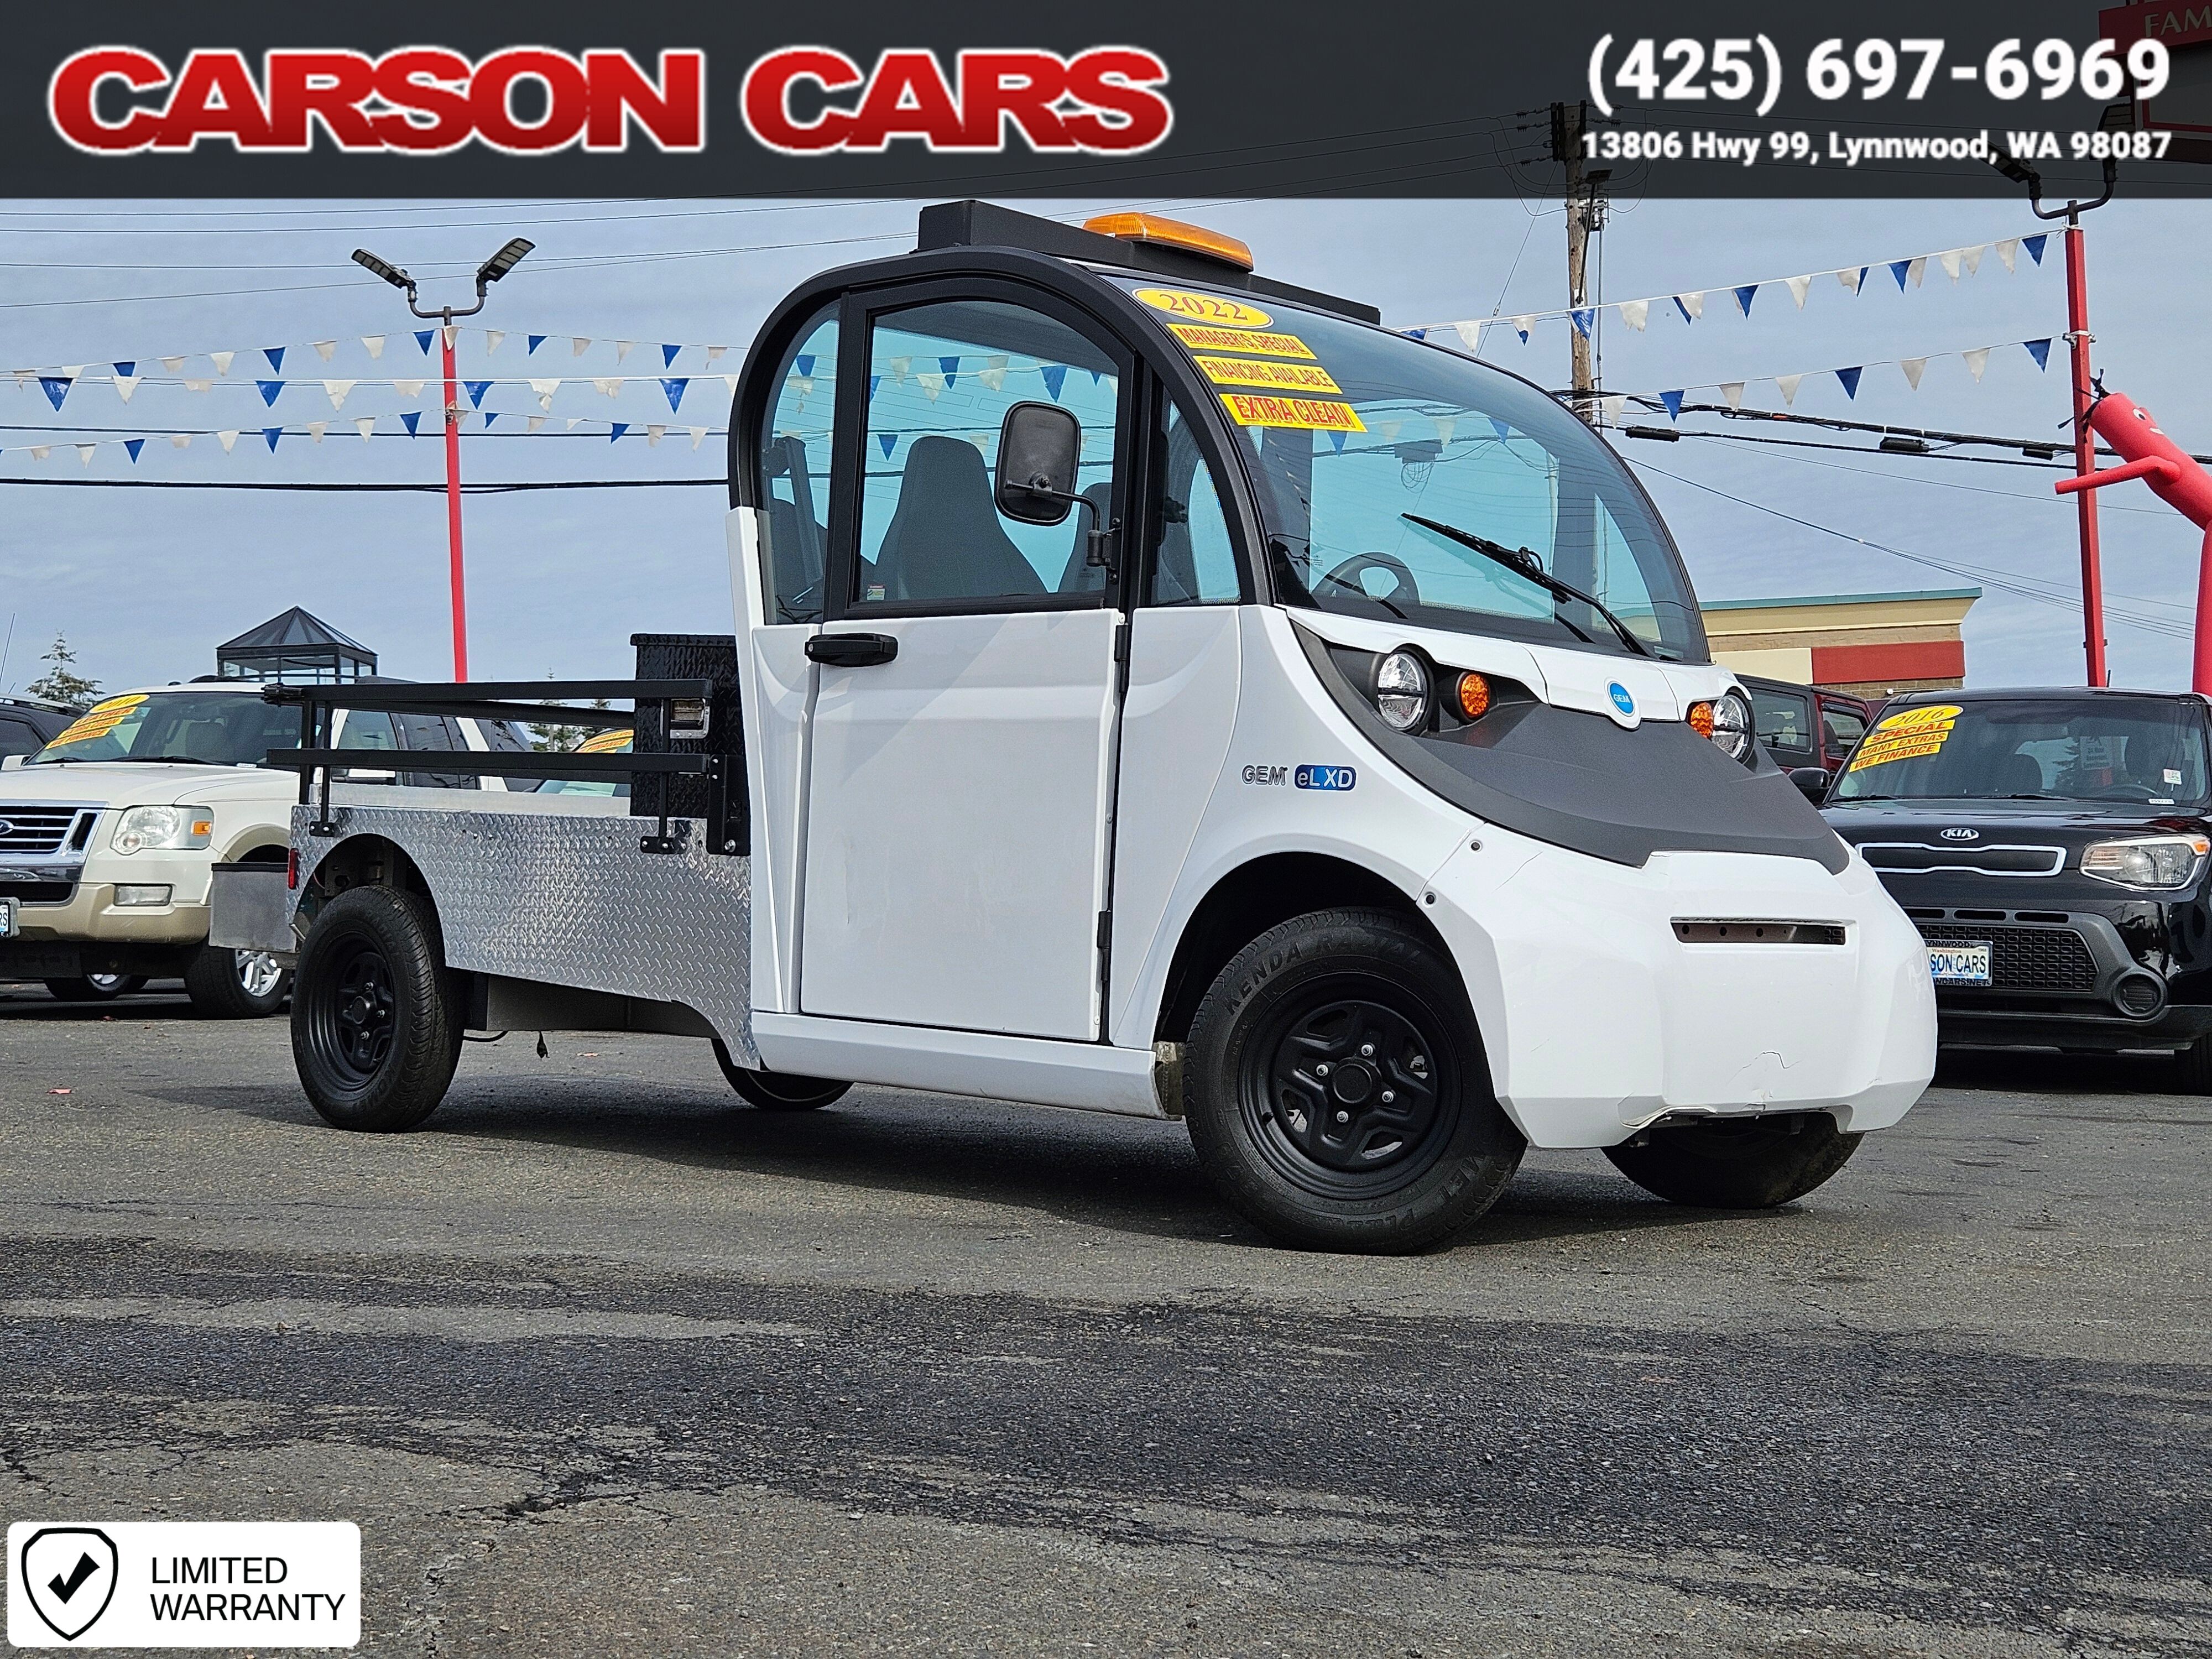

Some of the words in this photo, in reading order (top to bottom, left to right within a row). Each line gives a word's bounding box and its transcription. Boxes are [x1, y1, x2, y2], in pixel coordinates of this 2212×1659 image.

[1159, 293, 1248, 320] 2022
[1176, 327, 1256, 348] MANAGER'S
[1251, 335, 1308, 354] SPECIAL
[1202, 360, 1273, 382] FINANCING
[1267, 366, 1335, 387] AVAILABLE
[1232, 395, 1298, 424] EXTRA
[1292, 400, 1355, 427] CLEAN
[1613, 693, 1631, 703] GEM
[75, 707, 134, 726] LEATHER
[1888, 707, 1950, 728] 2016
[1870, 722, 1948, 743] SPECIAL
[1854, 757, 1875, 769] WE
[1876, 744, 1937, 762] FINANCE
[1859, 741, 1896, 758] MANY
[1897, 733, 1946, 747] EXTRAS
[1242, 764, 1287, 786] GEM
[1947, 829, 1972, 837] KIA
[1929, 953, 1952, 972] SON
[1956, 954, 1986, 974] CARS
[1224, 942, 1302, 1016] KENDA
